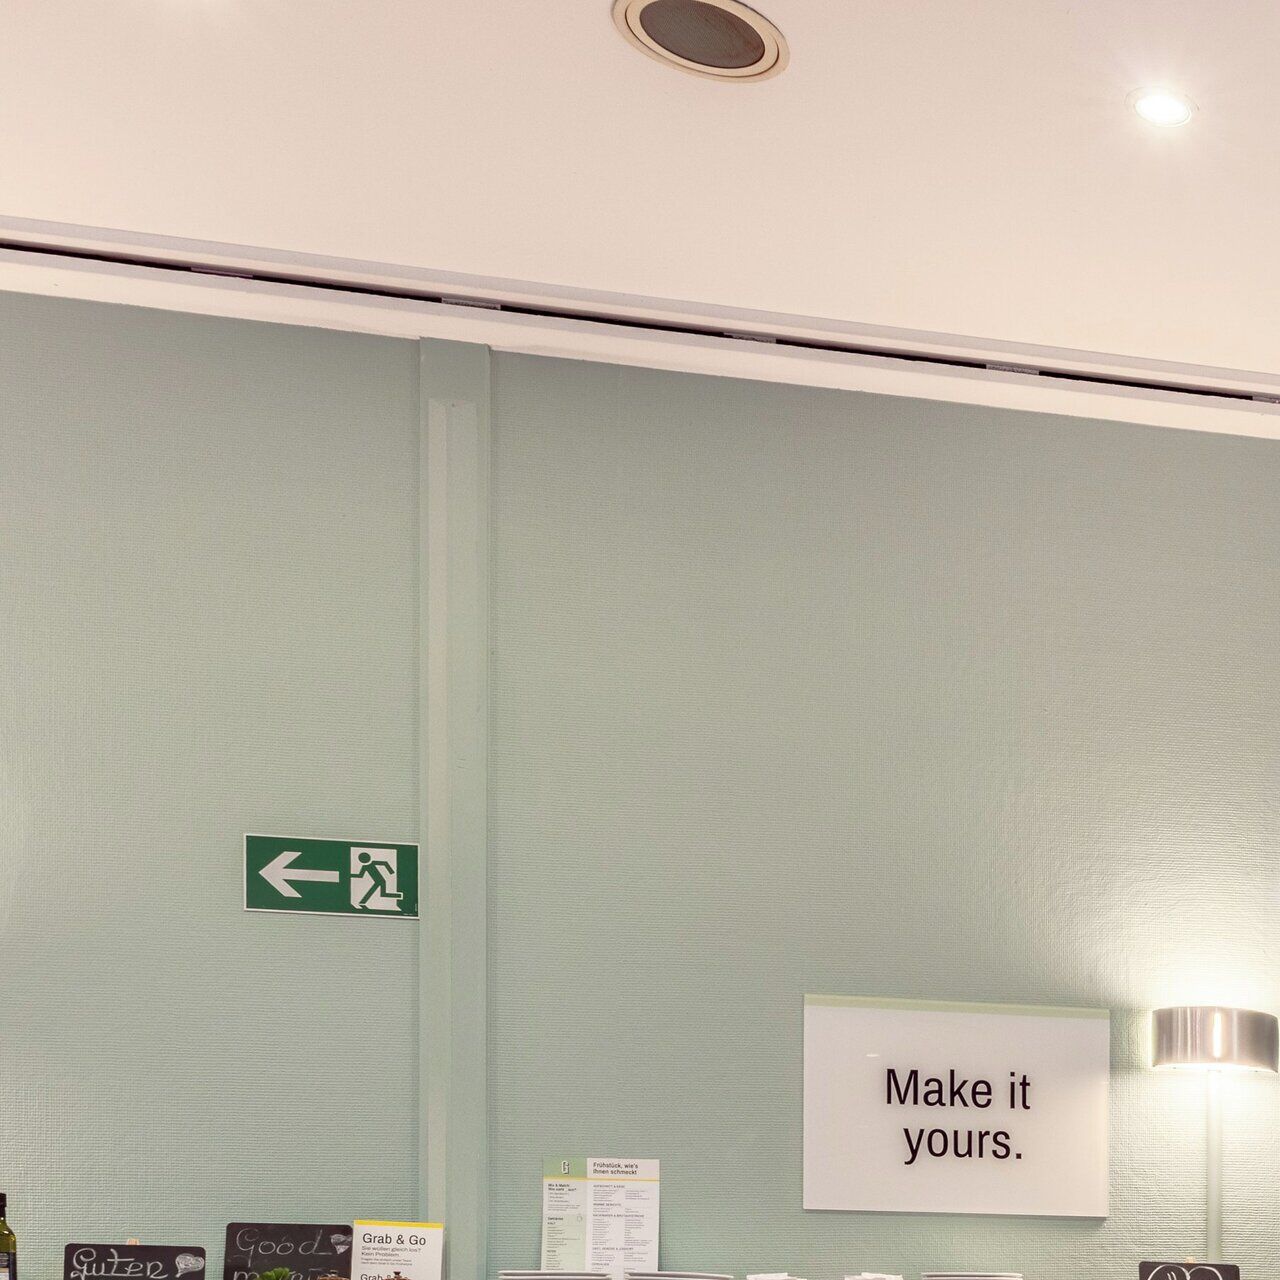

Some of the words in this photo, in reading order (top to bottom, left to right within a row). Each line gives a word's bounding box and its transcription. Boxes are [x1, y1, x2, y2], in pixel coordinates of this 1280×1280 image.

[887, 1068, 992, 1108] Make
[1010, 1071, 1031, 1109] it
[903, 1128, 1022, 1165] yours.
[236, 1228, 333, 1268] Good
[362, 1232, 392, 1244] Grab
[396, 1234, 405, 1244] &
[409, 1235, 426, 1245] Go
